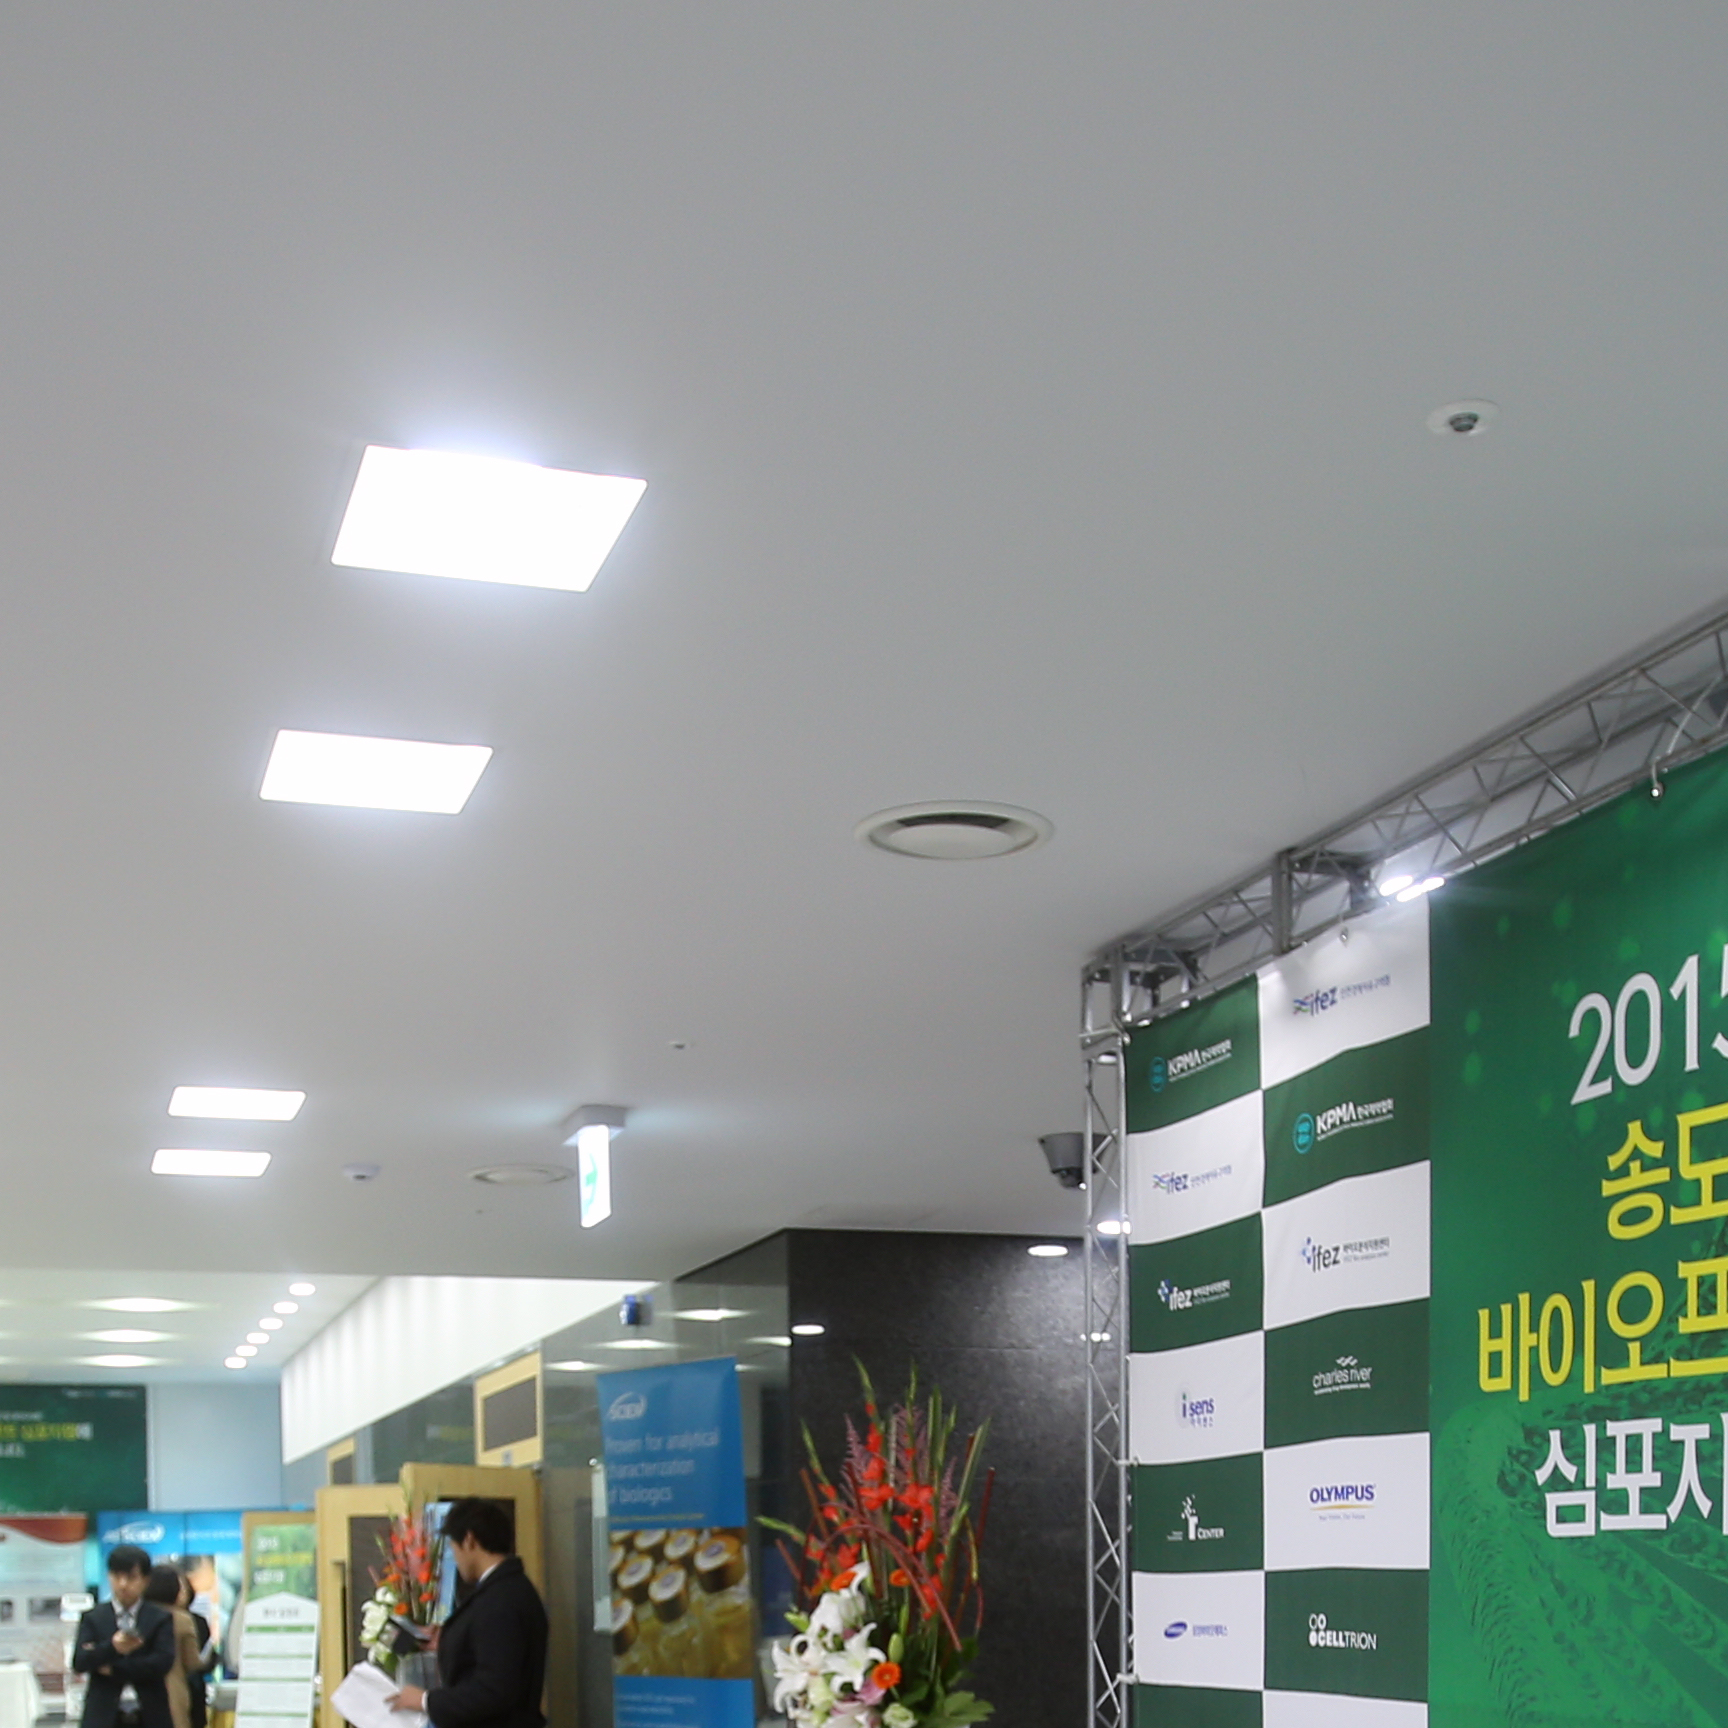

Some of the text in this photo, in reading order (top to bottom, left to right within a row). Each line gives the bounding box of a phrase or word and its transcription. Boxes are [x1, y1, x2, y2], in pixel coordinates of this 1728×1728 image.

[1167, 1049, 1202, 1075] KPMA
[1317, 1102, 1357, 1134] KPMA
[1309, 1484, 1375, 1504] OLYMPUS
